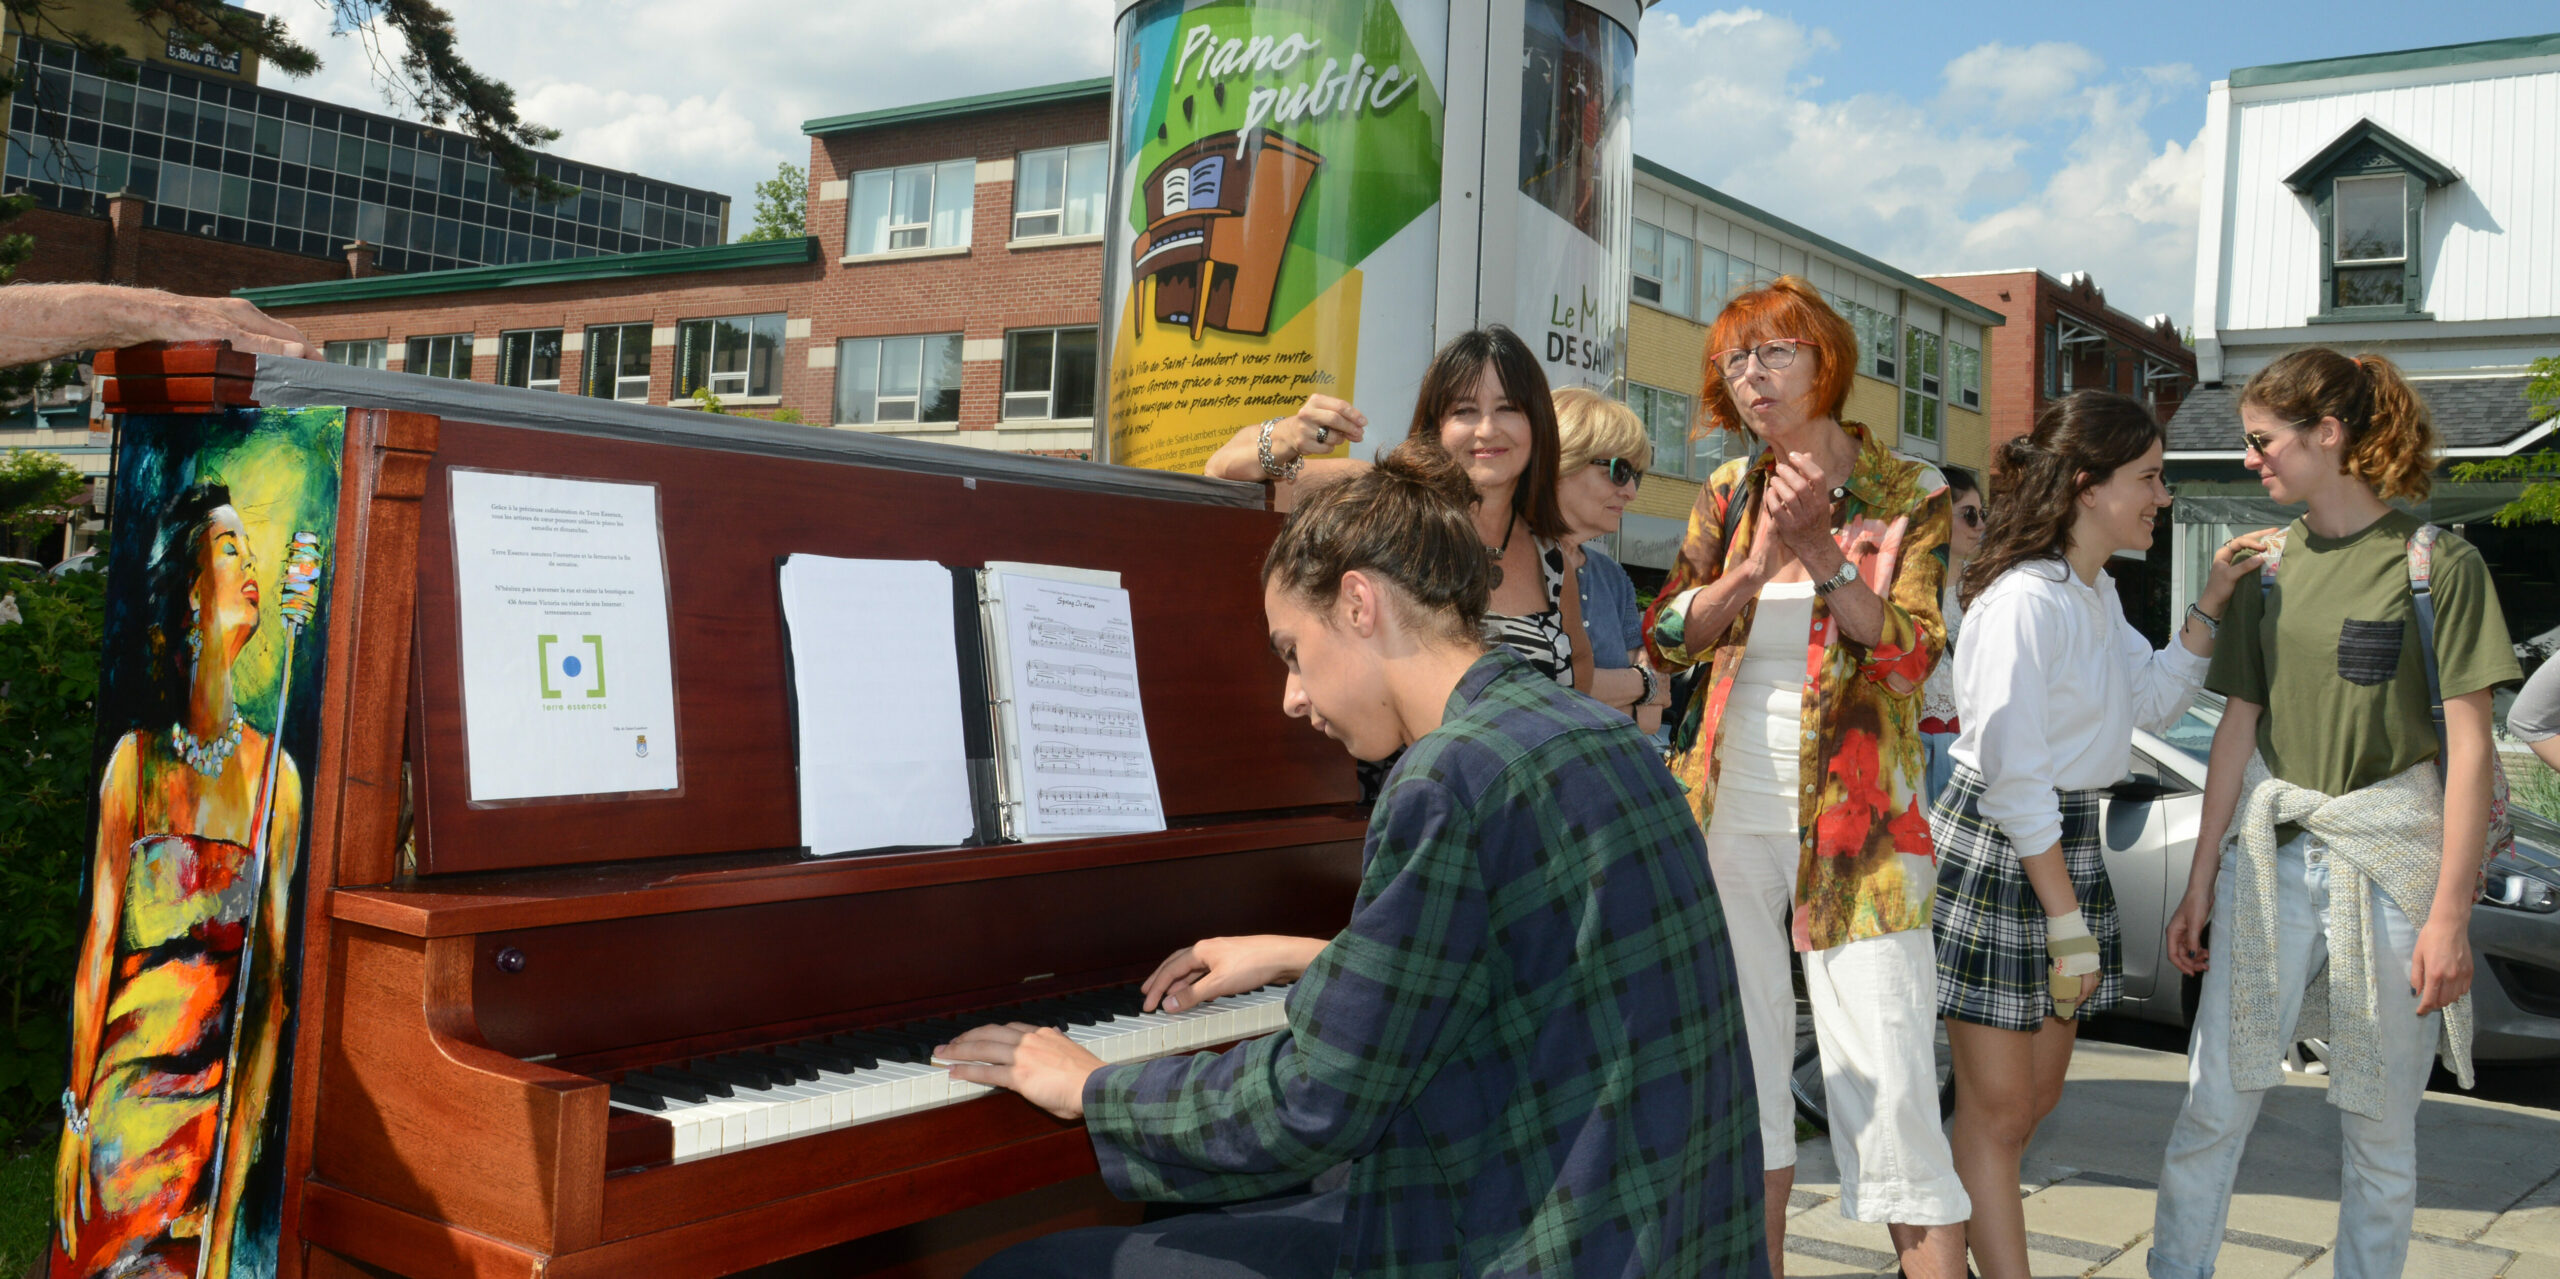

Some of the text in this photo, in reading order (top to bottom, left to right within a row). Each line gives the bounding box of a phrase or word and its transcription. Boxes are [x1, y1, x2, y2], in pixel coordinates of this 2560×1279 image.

[1174, 24, 1321, 84] Piano
[1236, 53, 1417, 160] public
[1551, 294, 1574, 328] Le
[1546, 332, 1578, 366] DE
[1136, 361, 1149, 376] Ville
[1150, 361, 1160, 372] de
[1161, 352, 1239, 372] Saint-Lambert
[1242, 353, 1271, 364] vous
[1274, 350, 1313, 364] invite
[1147, 379, 1181, 396] Gordon
[1180, 376, 1212, 394] grâce
[1214, 375, 1222, 386] à
[1226, 377, 1249, 387] son
[1249, 374, 1290, 391] piano
[1290, 370, 1336, 390] public.
[1140, 401, 1173, 418] musique
[1174, 400, 1188, 409] ou
[1189, 394, 1241, 415] pianistes
[1135, 420, 1154, 434] vous!
[1175, 429, 1216, 444] Saint-Lambert
[542, 703, 607, 711] terre essences
